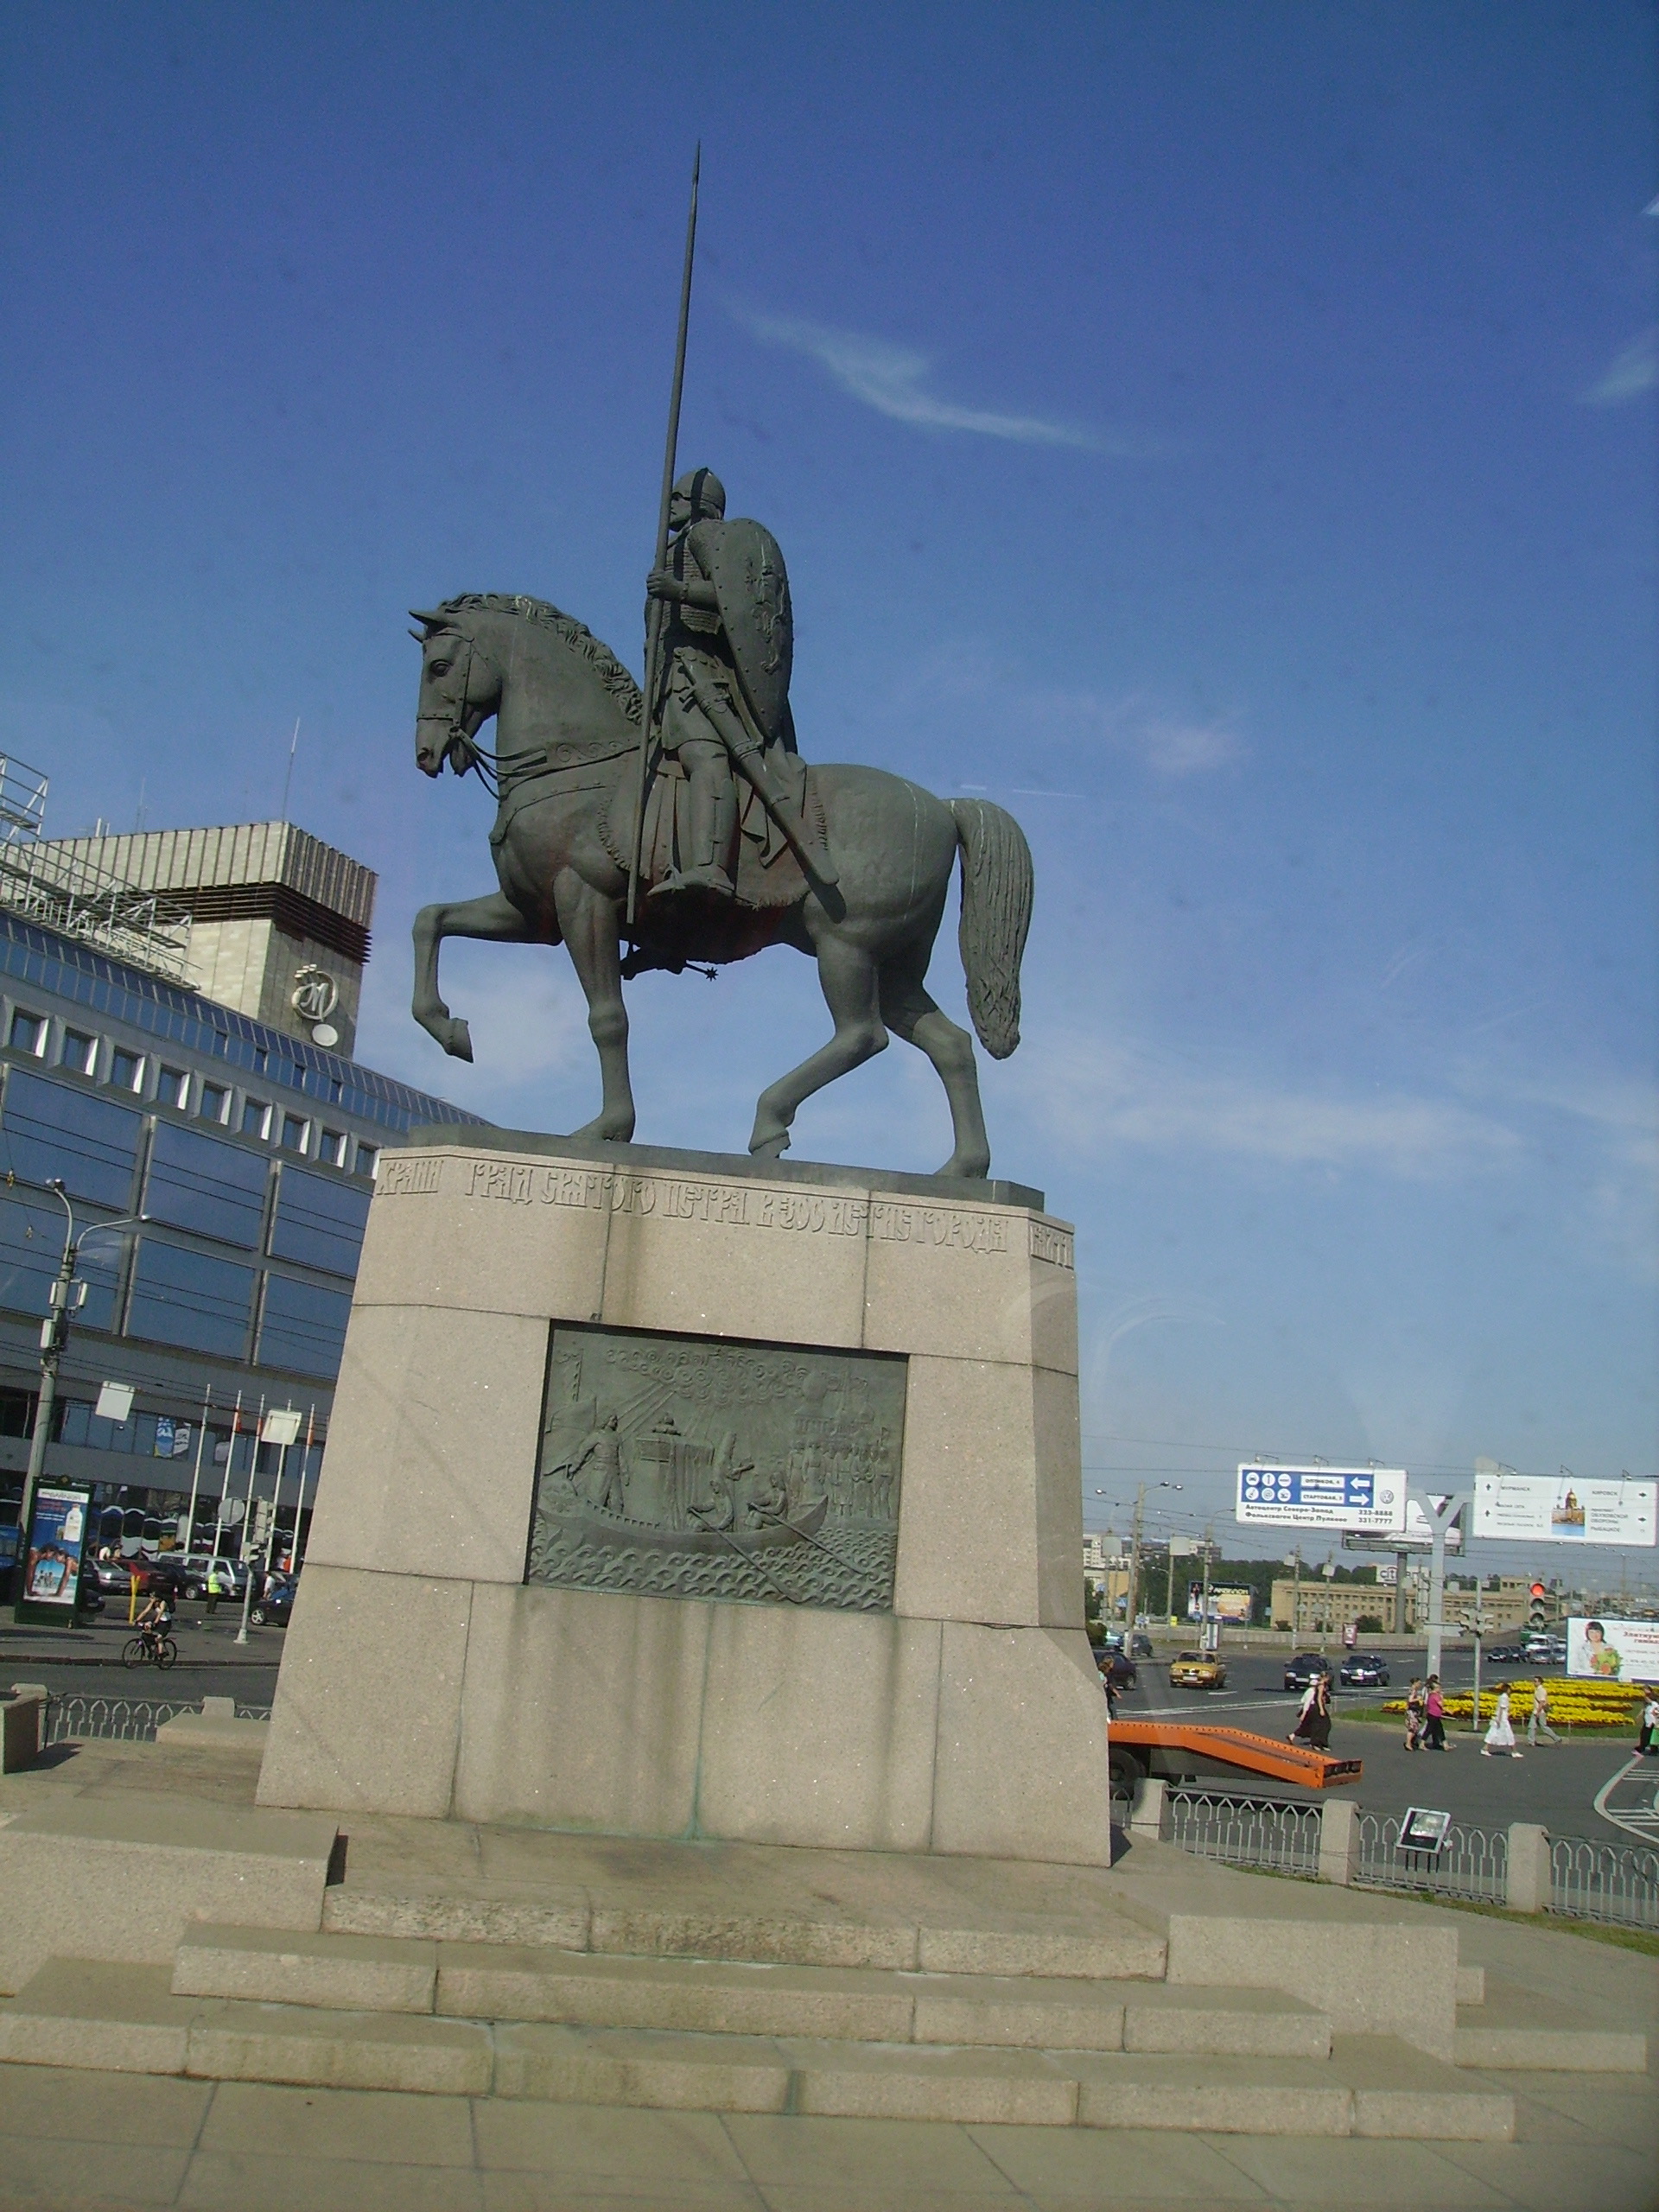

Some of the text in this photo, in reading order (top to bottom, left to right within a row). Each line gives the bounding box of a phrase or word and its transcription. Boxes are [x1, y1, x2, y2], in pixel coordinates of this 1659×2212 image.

[465, 1163, 533, 1205] ГРАД
[540, 1172, 657, 1216] СВЯТОГО
[662, 1183, 751, 1227] ПЕТРА
[916, 1211, 1008, 1255] ГОРОДА
